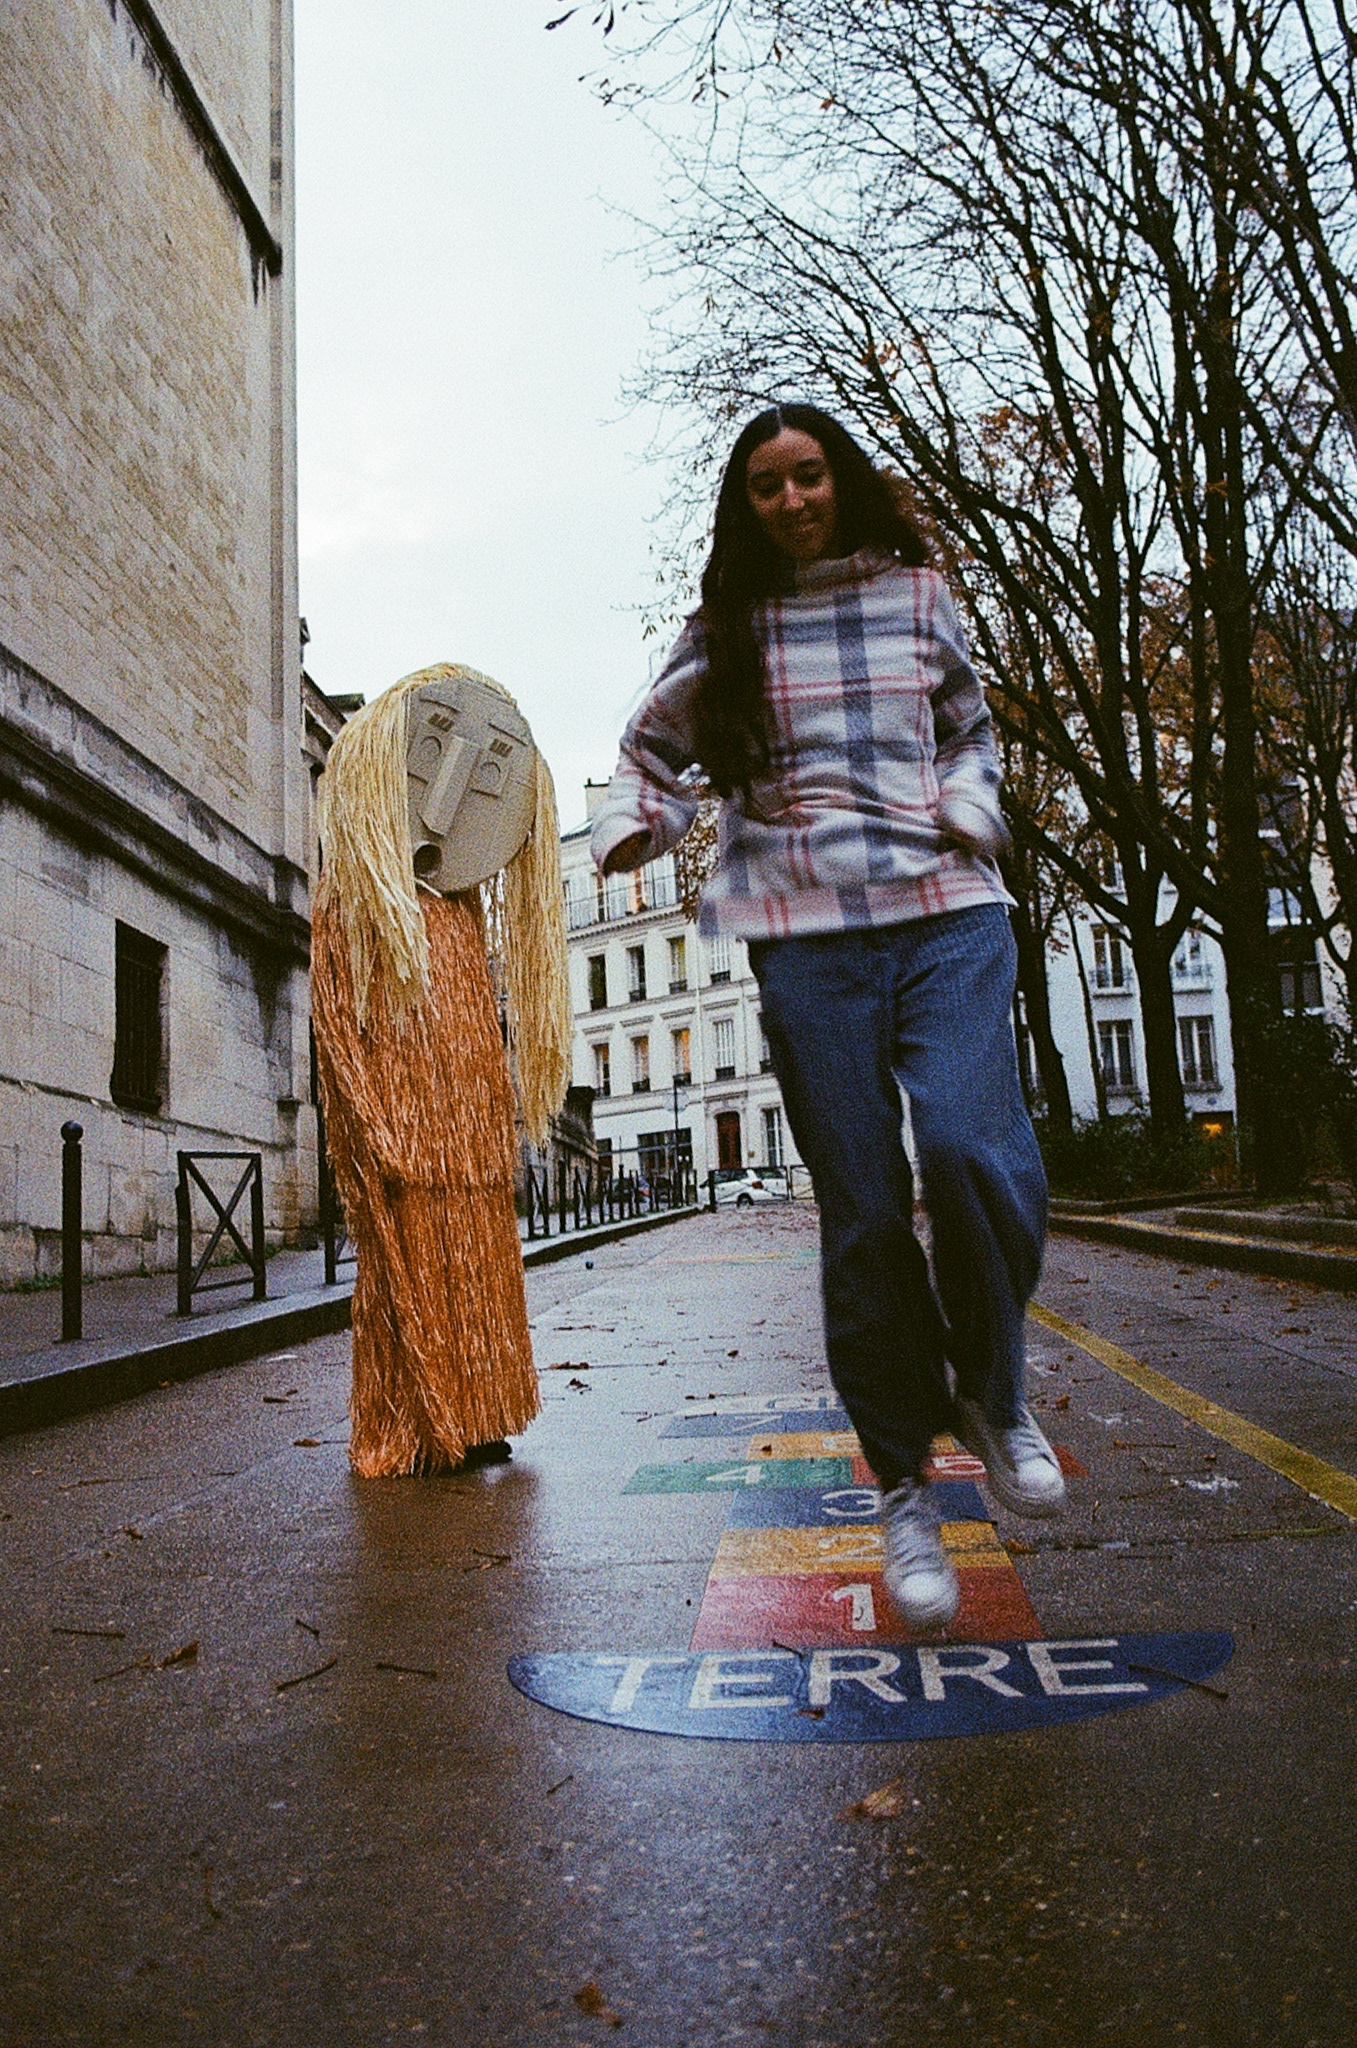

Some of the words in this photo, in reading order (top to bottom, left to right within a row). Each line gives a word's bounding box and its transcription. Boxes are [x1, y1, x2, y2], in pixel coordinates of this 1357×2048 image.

[733, 1413, 783, 1431] 7
[706, 1465, 766, 1485] 4
[932, 1455, 987, 1474] 5
[821, 1489, 882, 1517] 3
[818, 1532, 886, 1562] 2
[832, 1583, 876, 1631] 1
[595, 1638, 1149, 1712] TERRE
